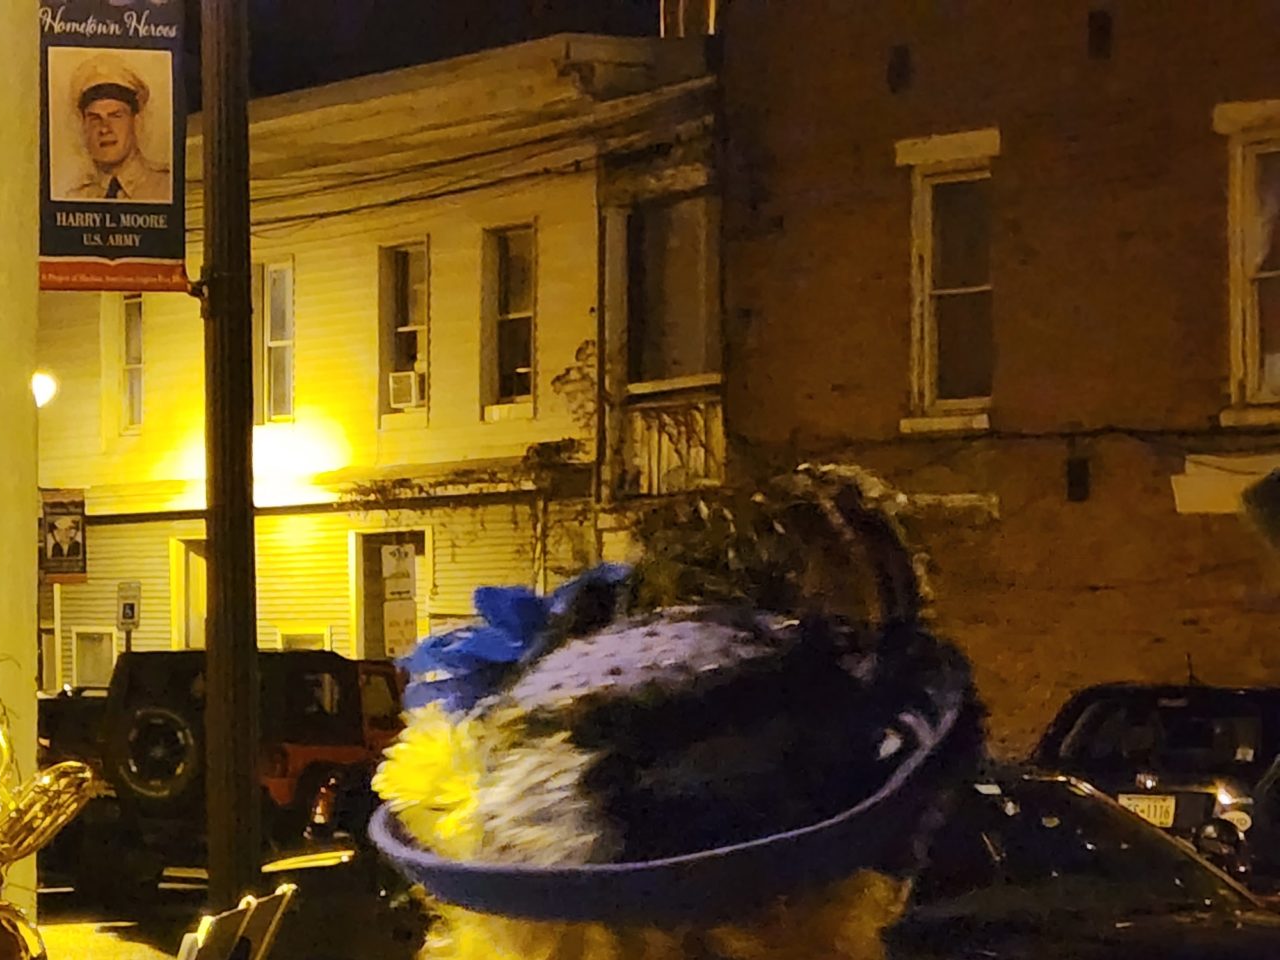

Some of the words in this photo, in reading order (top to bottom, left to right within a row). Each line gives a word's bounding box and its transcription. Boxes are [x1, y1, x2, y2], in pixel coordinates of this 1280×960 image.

[39, 6, 121, 38] Hometown
[124, 10, 177, 37] Heroes
[56, 212, 102, 227] HARRY
[105, 213, 117, 228] L.
[120, 214, 167, 228] MOORE
[82, 233, 104, 246] U.S.
[107, 234, 141, 246] ARMY
